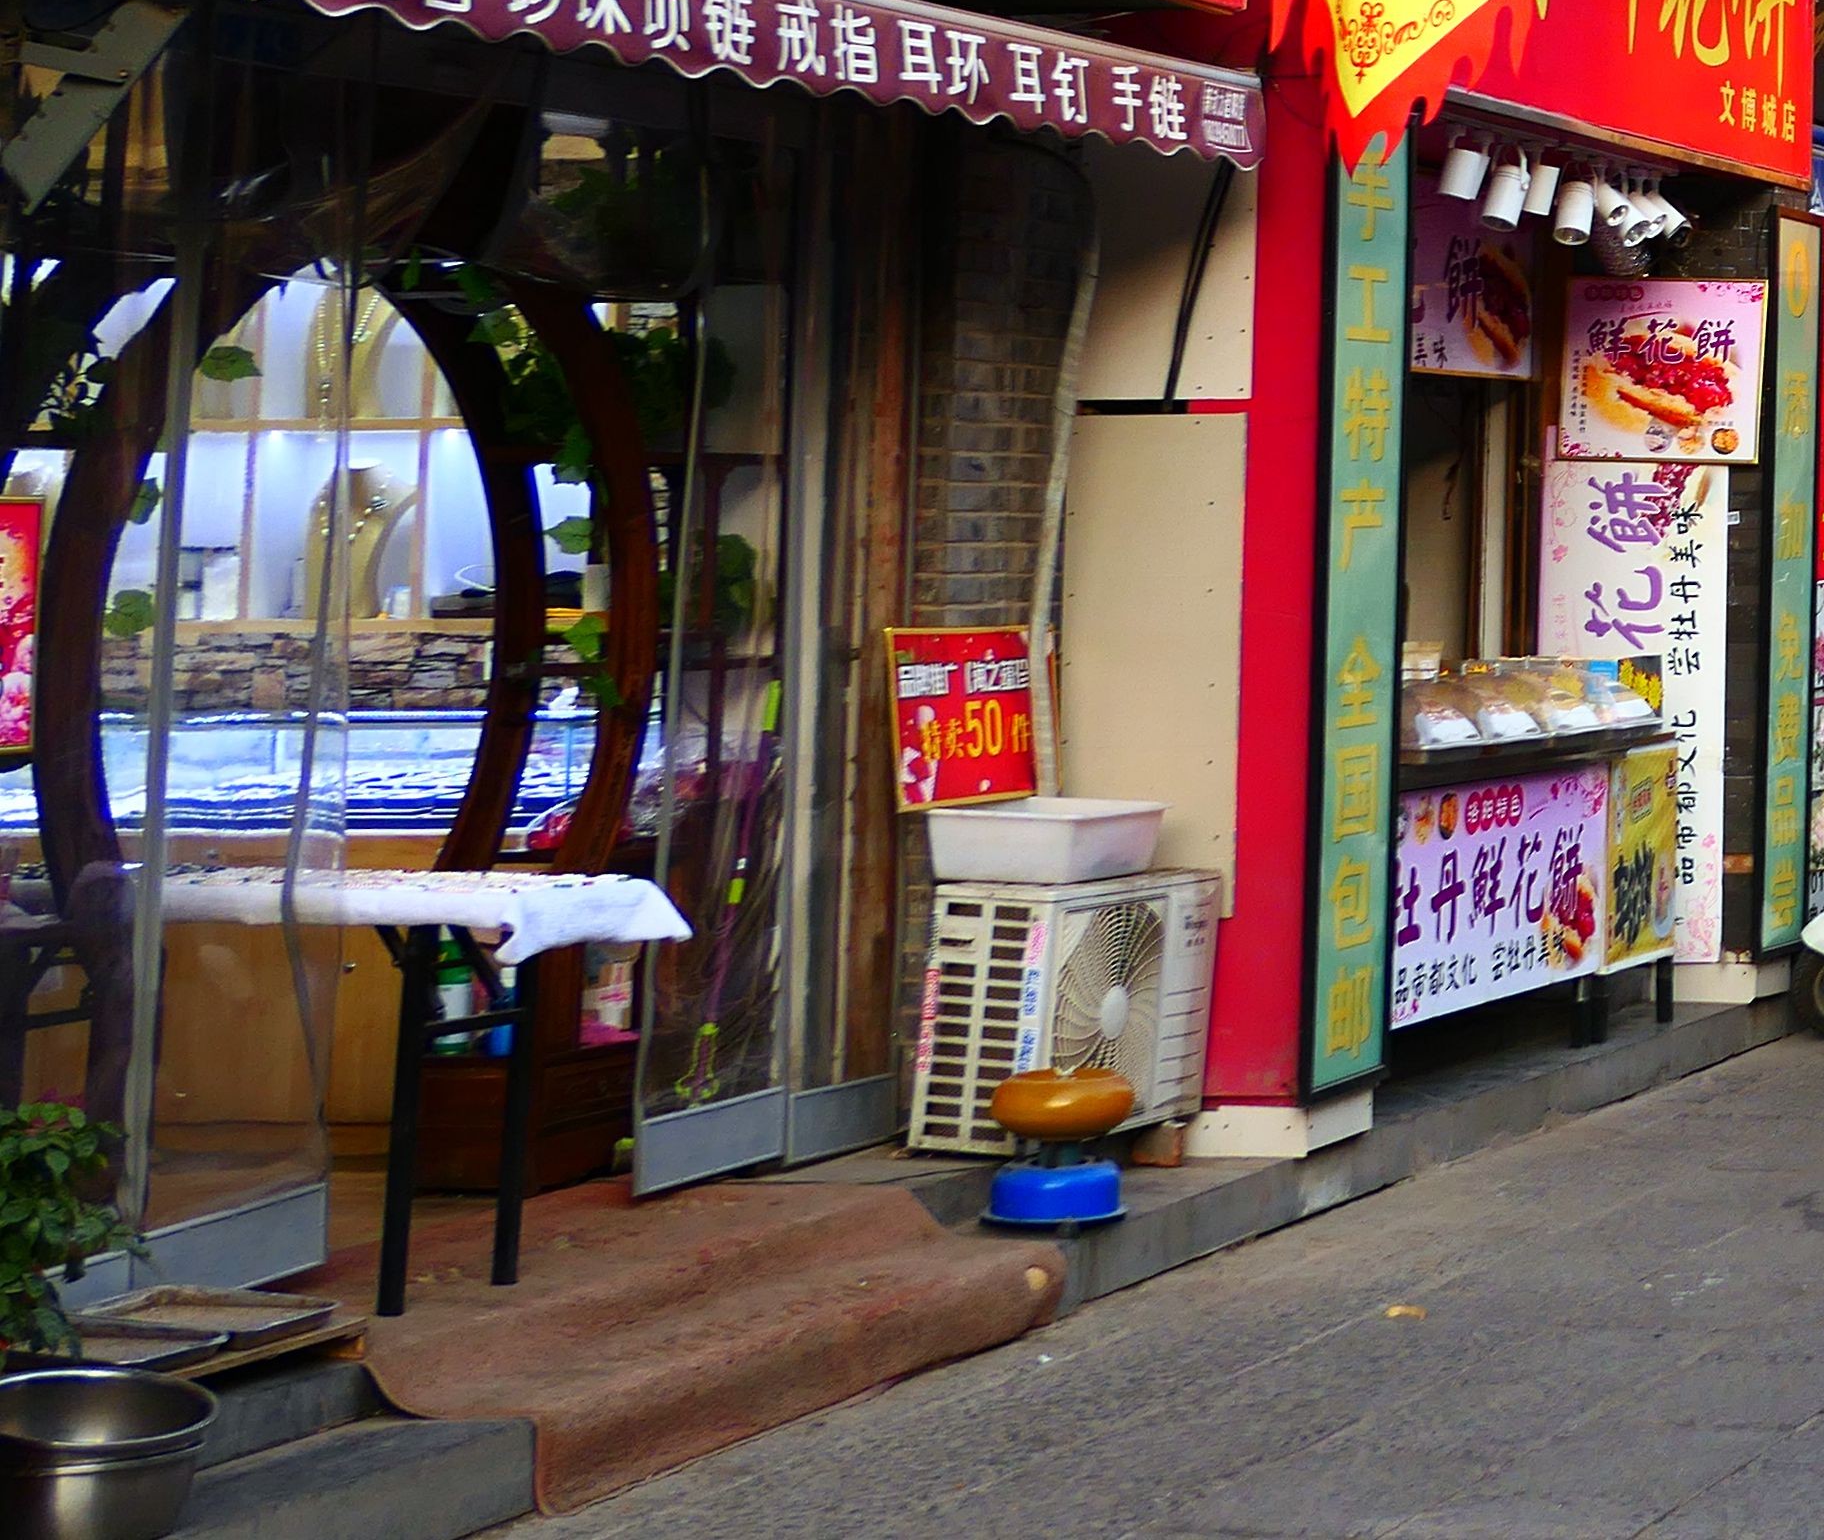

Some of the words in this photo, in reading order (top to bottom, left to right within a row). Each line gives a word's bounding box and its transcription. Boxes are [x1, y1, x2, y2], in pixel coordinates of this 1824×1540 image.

[898, 20, 990, 105] 耳环
[1006, 43, 1089, 124] 耳钉
[1112, 66, 1188, 140] 手链
[1719, 81, 1796, 143] 文博城店
[1338, 152, 1395, 572] 手工特产
[1326, 634, 1381, 1060] 全国包邮
